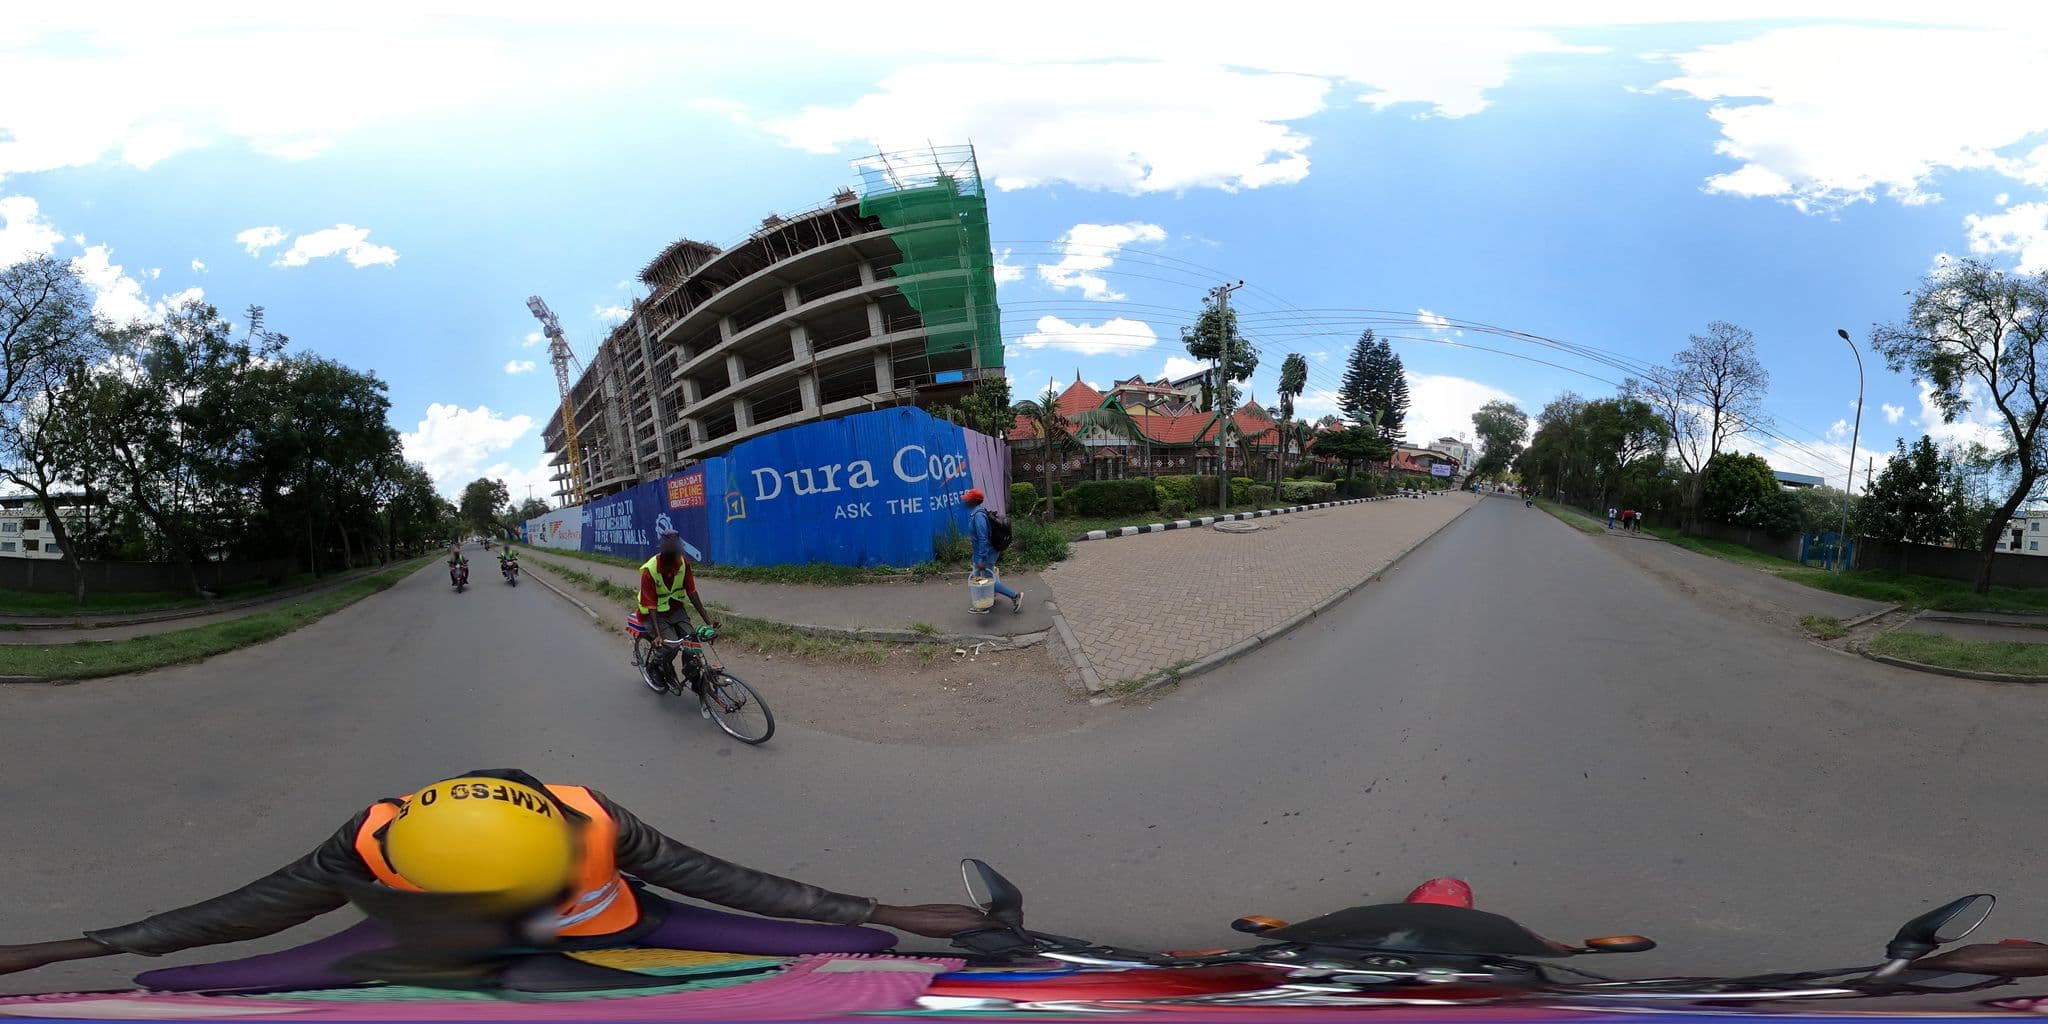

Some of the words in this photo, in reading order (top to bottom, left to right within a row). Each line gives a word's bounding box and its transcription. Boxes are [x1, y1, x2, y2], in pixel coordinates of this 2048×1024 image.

[752, 460, 879, 501] Dura
[893, 444, 967, 483] Coat
[624, 499, 634, 515] TO
[834, 502, 873, 520] ASK
[886, 497, 923, 515] THE
